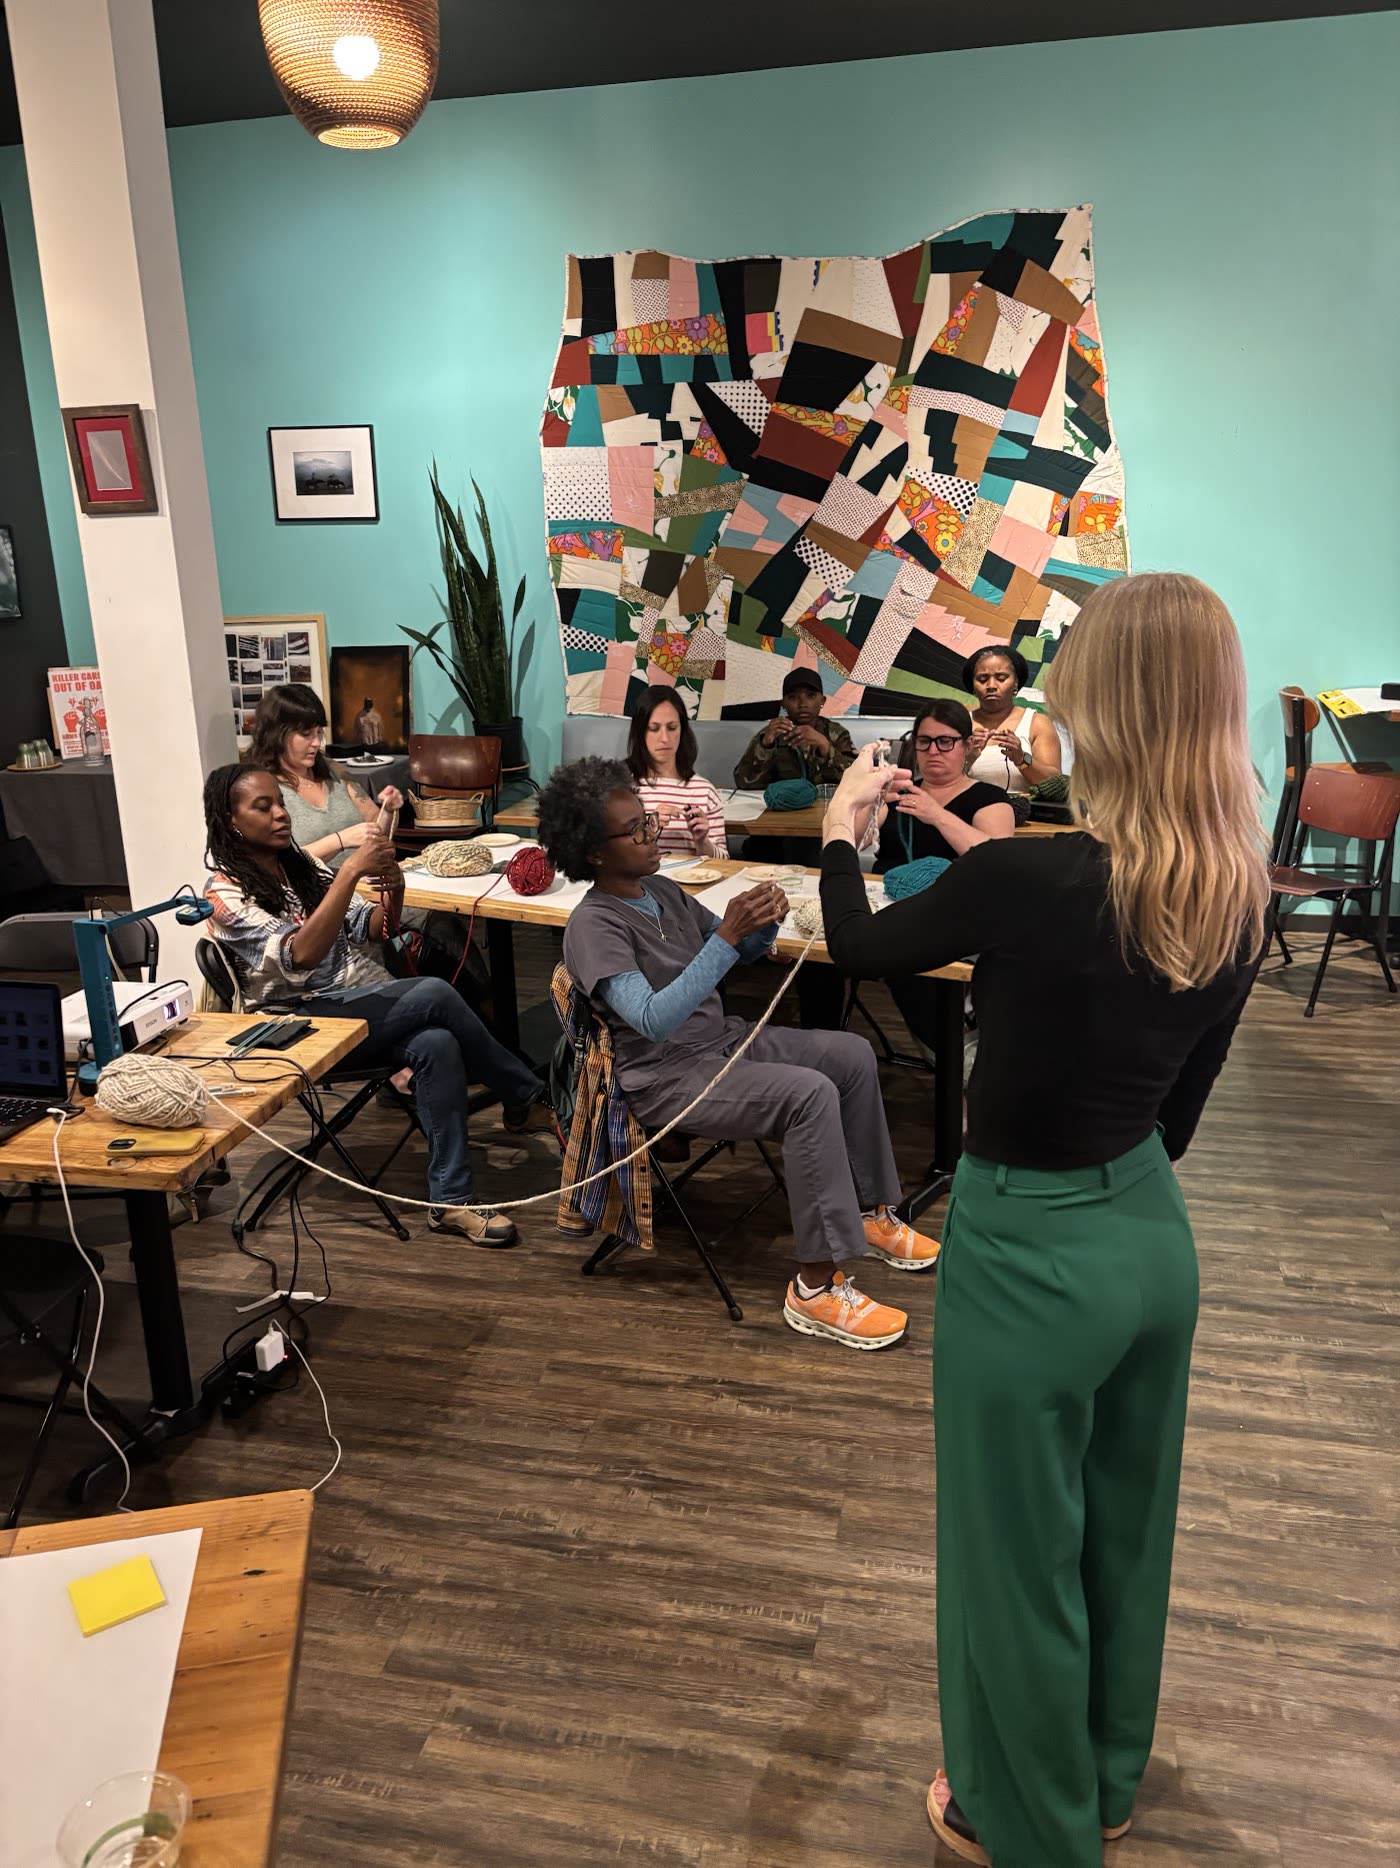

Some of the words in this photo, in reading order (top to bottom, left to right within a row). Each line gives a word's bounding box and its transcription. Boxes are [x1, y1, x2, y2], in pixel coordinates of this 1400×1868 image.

[52, 673, 79, 682] KILLER
[54, 683, 72, 692] OUT
[75, 681, 87, 691] OF
